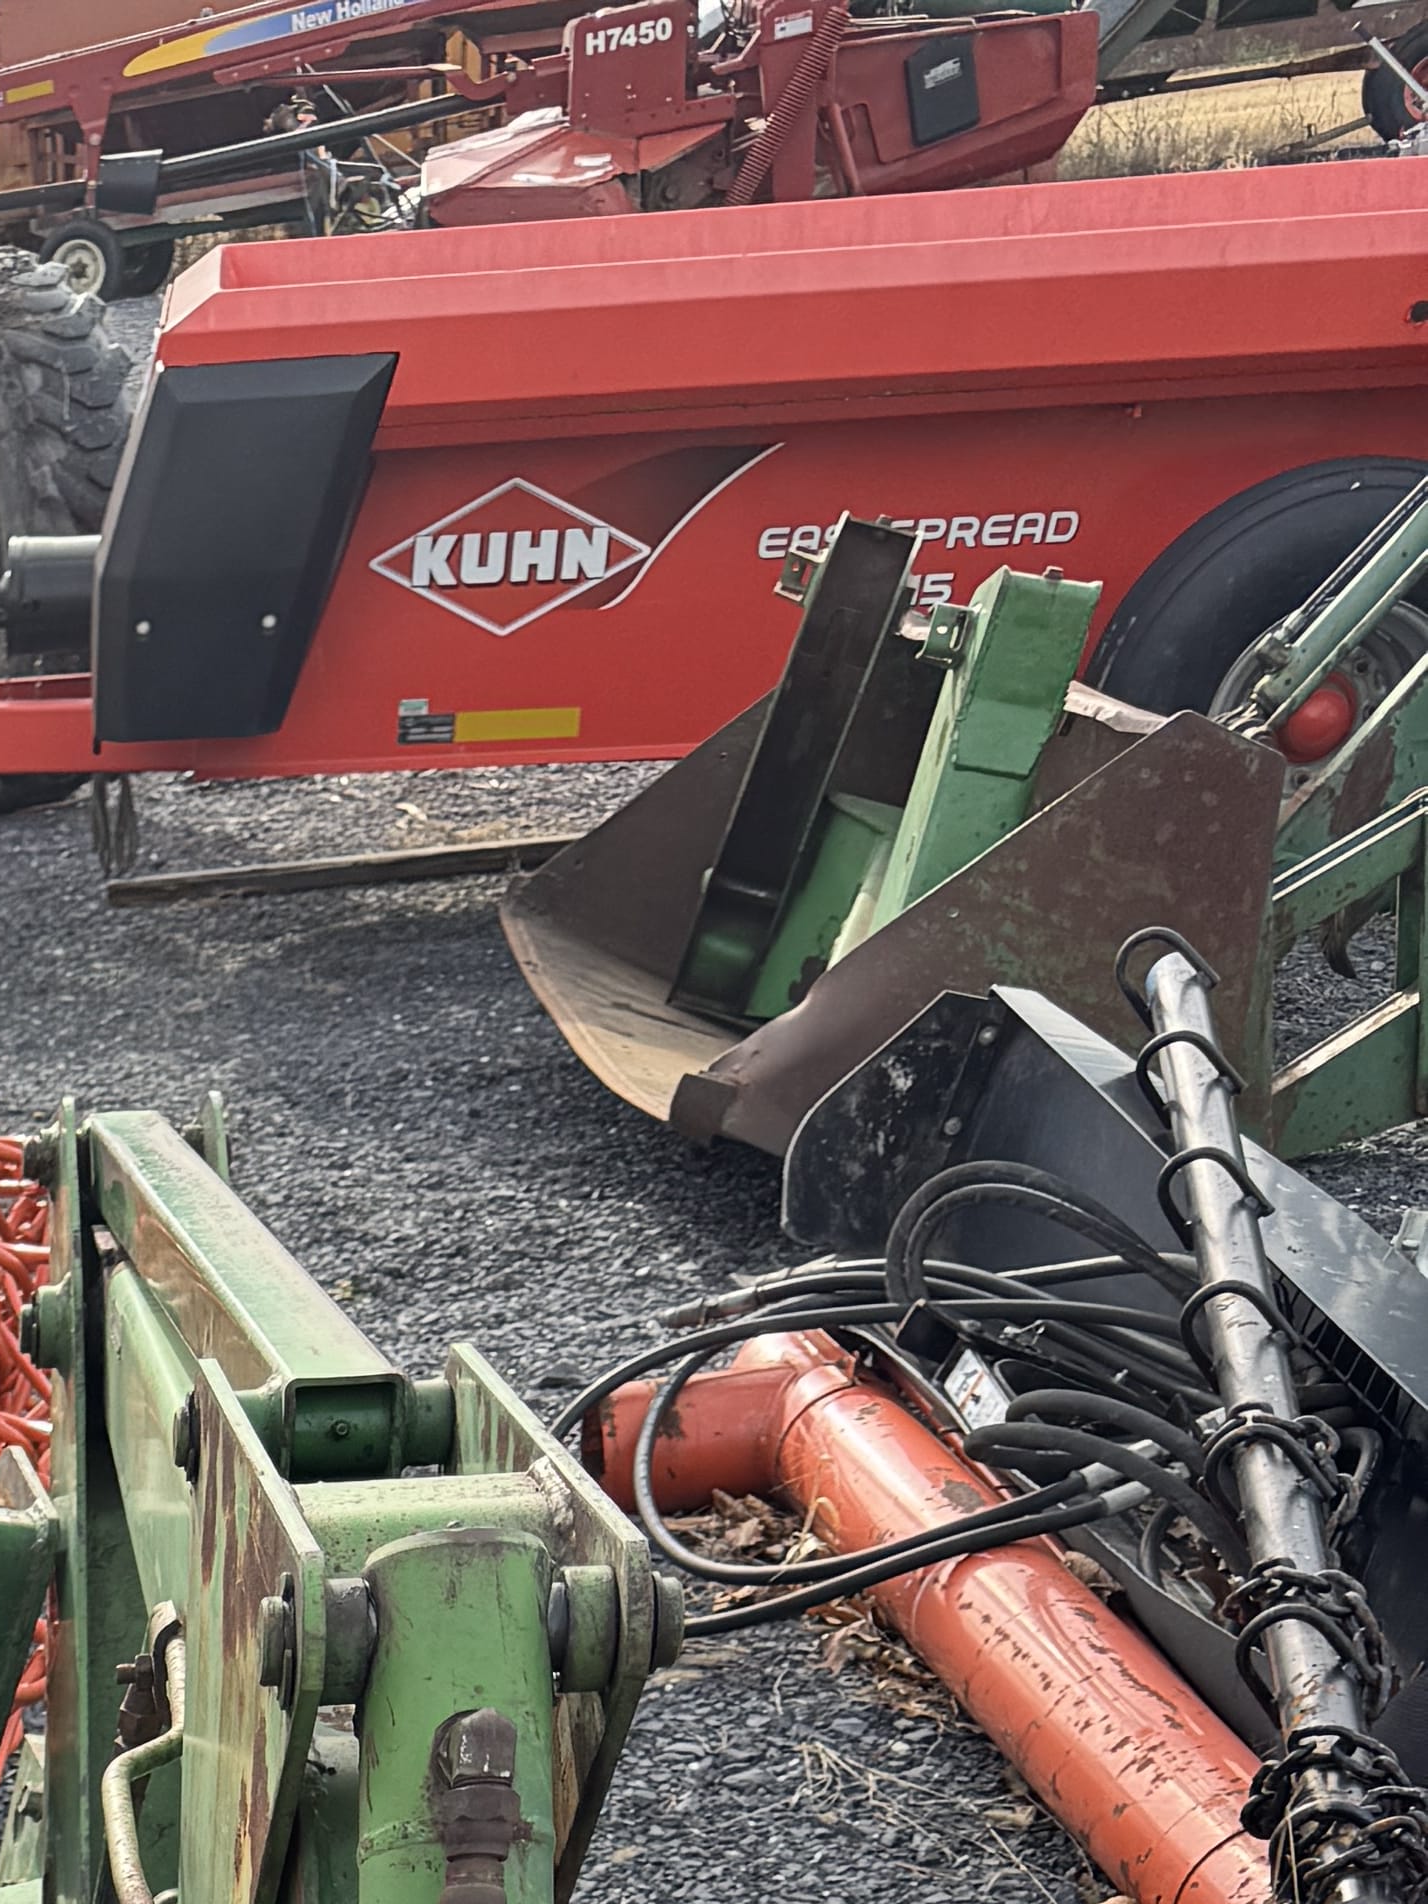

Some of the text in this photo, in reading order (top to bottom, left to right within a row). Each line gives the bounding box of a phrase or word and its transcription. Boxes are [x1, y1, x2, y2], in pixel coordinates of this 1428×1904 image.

[291, 0, 407, 32] New Hollan
[586, 17, 673, 56] H7450
[411, 527, 610, 588] KUHN
